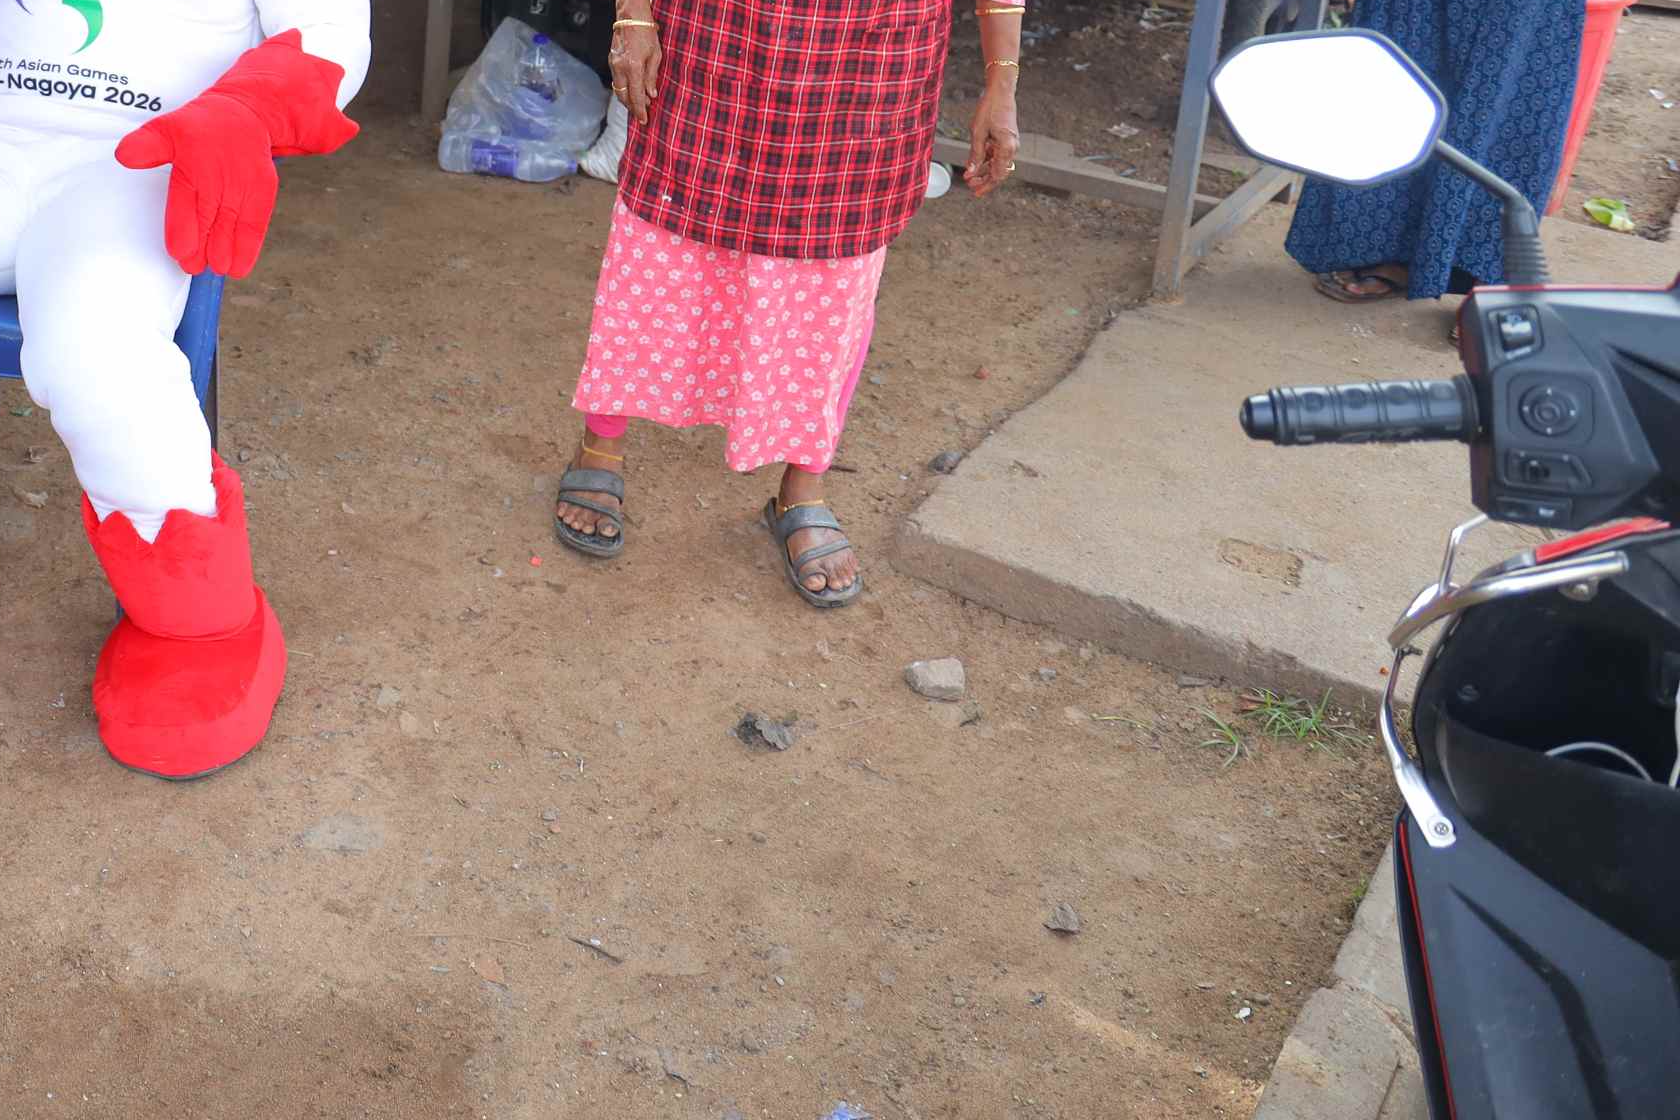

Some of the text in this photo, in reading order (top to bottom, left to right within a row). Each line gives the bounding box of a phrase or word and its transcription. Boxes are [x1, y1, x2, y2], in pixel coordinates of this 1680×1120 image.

[16, 59, 61, 73] Asian
[67, 64, 128, 85] Games
[103, 86, 162, 112] 2026
